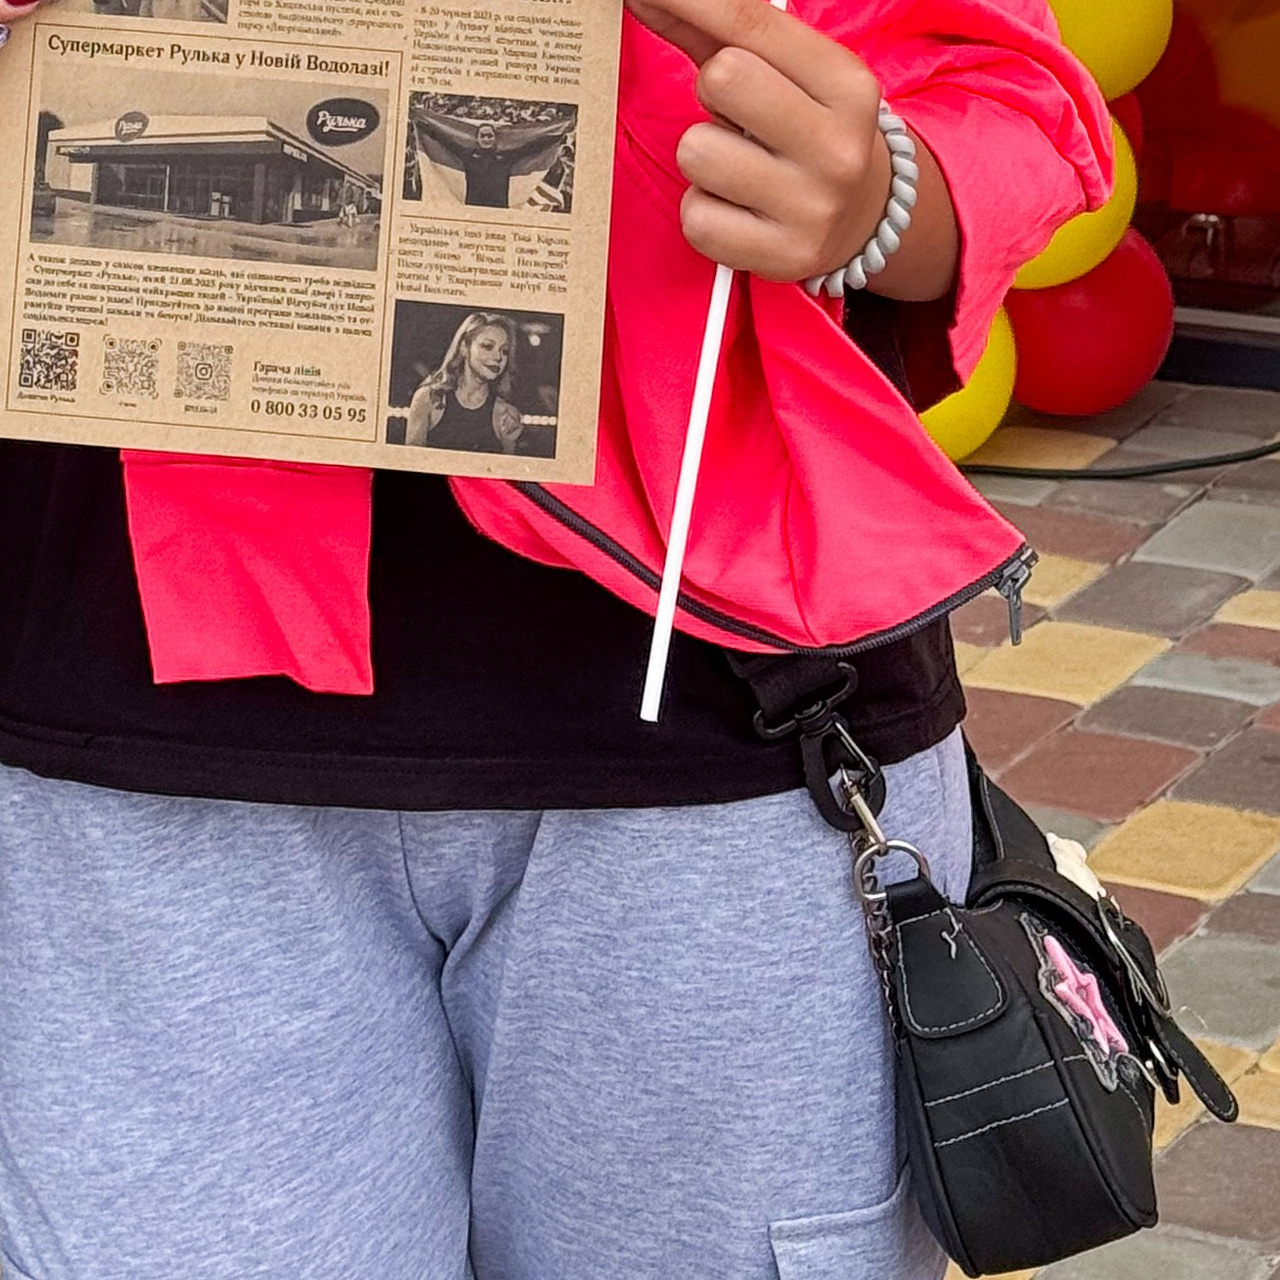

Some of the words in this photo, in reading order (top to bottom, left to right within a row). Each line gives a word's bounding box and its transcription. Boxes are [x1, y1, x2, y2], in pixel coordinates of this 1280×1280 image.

[48, 34, 164, 60] Супермаркет
[170, 44, 230, 65] Рулька
[236, 54, 246, 69] у
[250, 50, 301, 69] Новій
[307, 55, 389, 77] Водолазі!
[316, 110, 366, 134] Рулька
[251, 400, 260, 413] 0
[265, 401, 294, 416] 800
[298, 403, 318, 418] 33
[323, 406, 342, 420] 05
[348, 408, 366, 422] 95
